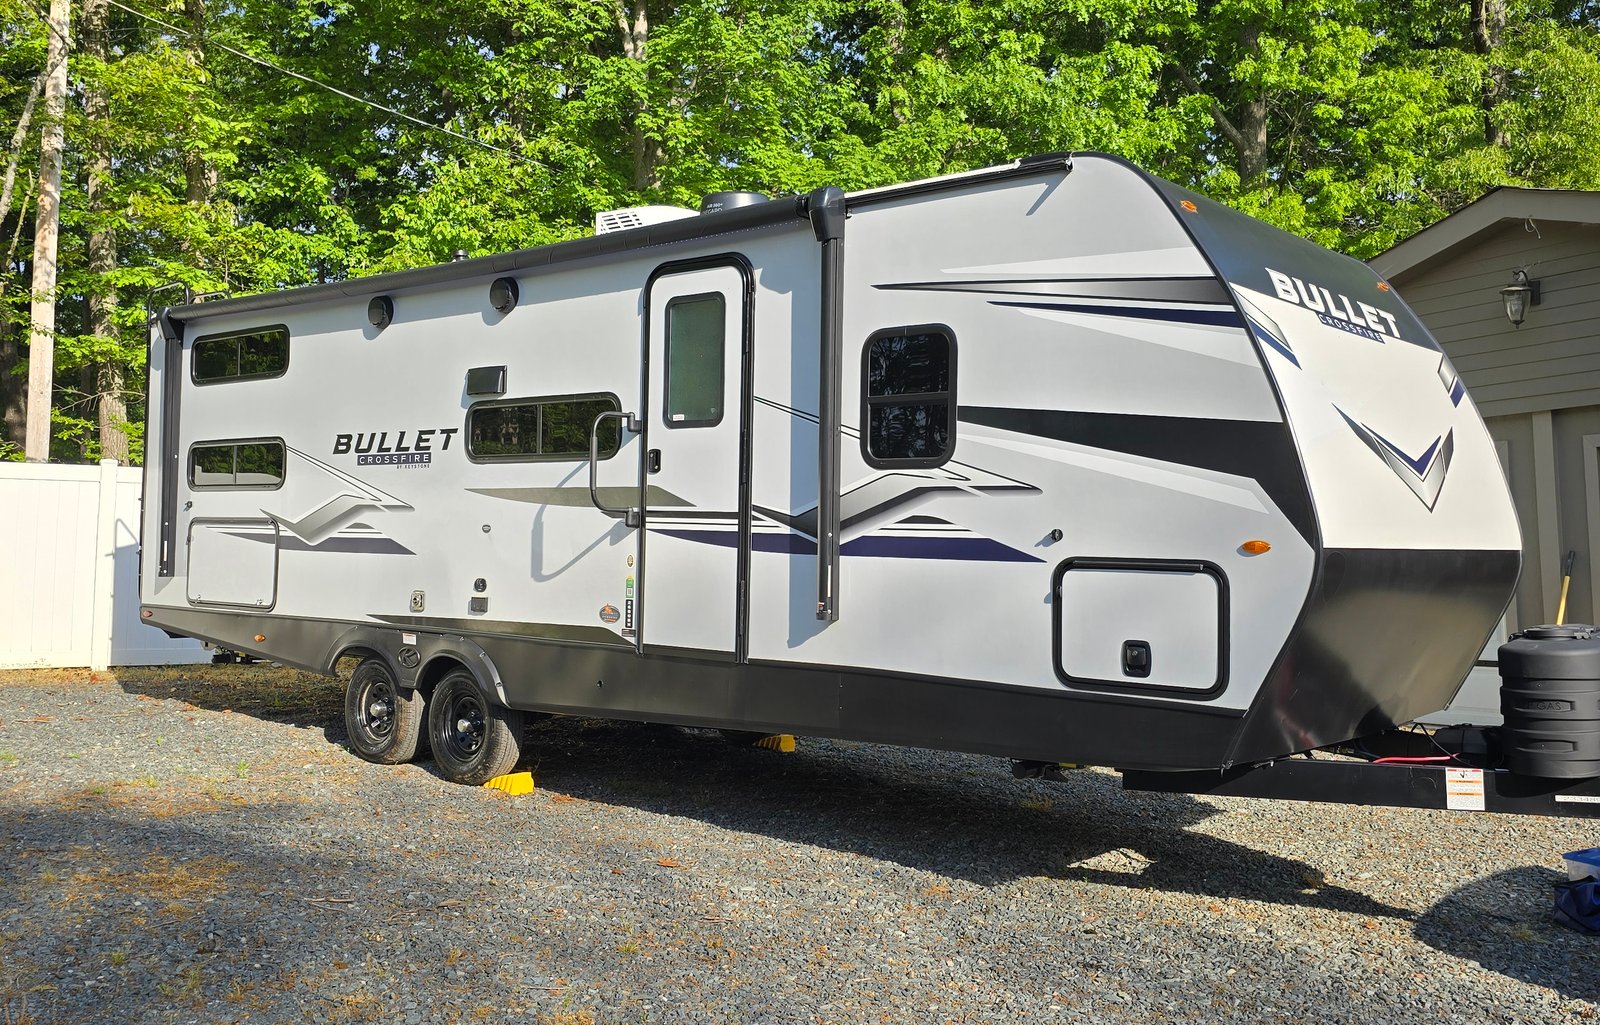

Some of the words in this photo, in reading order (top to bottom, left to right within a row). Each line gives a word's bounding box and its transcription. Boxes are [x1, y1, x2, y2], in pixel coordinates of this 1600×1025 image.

[1265, 267, 1400, 338] BULLET
[1318, 313, 1382, 342] CROSSFIRE
[332, 428, 459, 455] BULLET
[359, 454, 430, 464] CROSSFIRE
[1536, 701, 1562, 711] GAS
